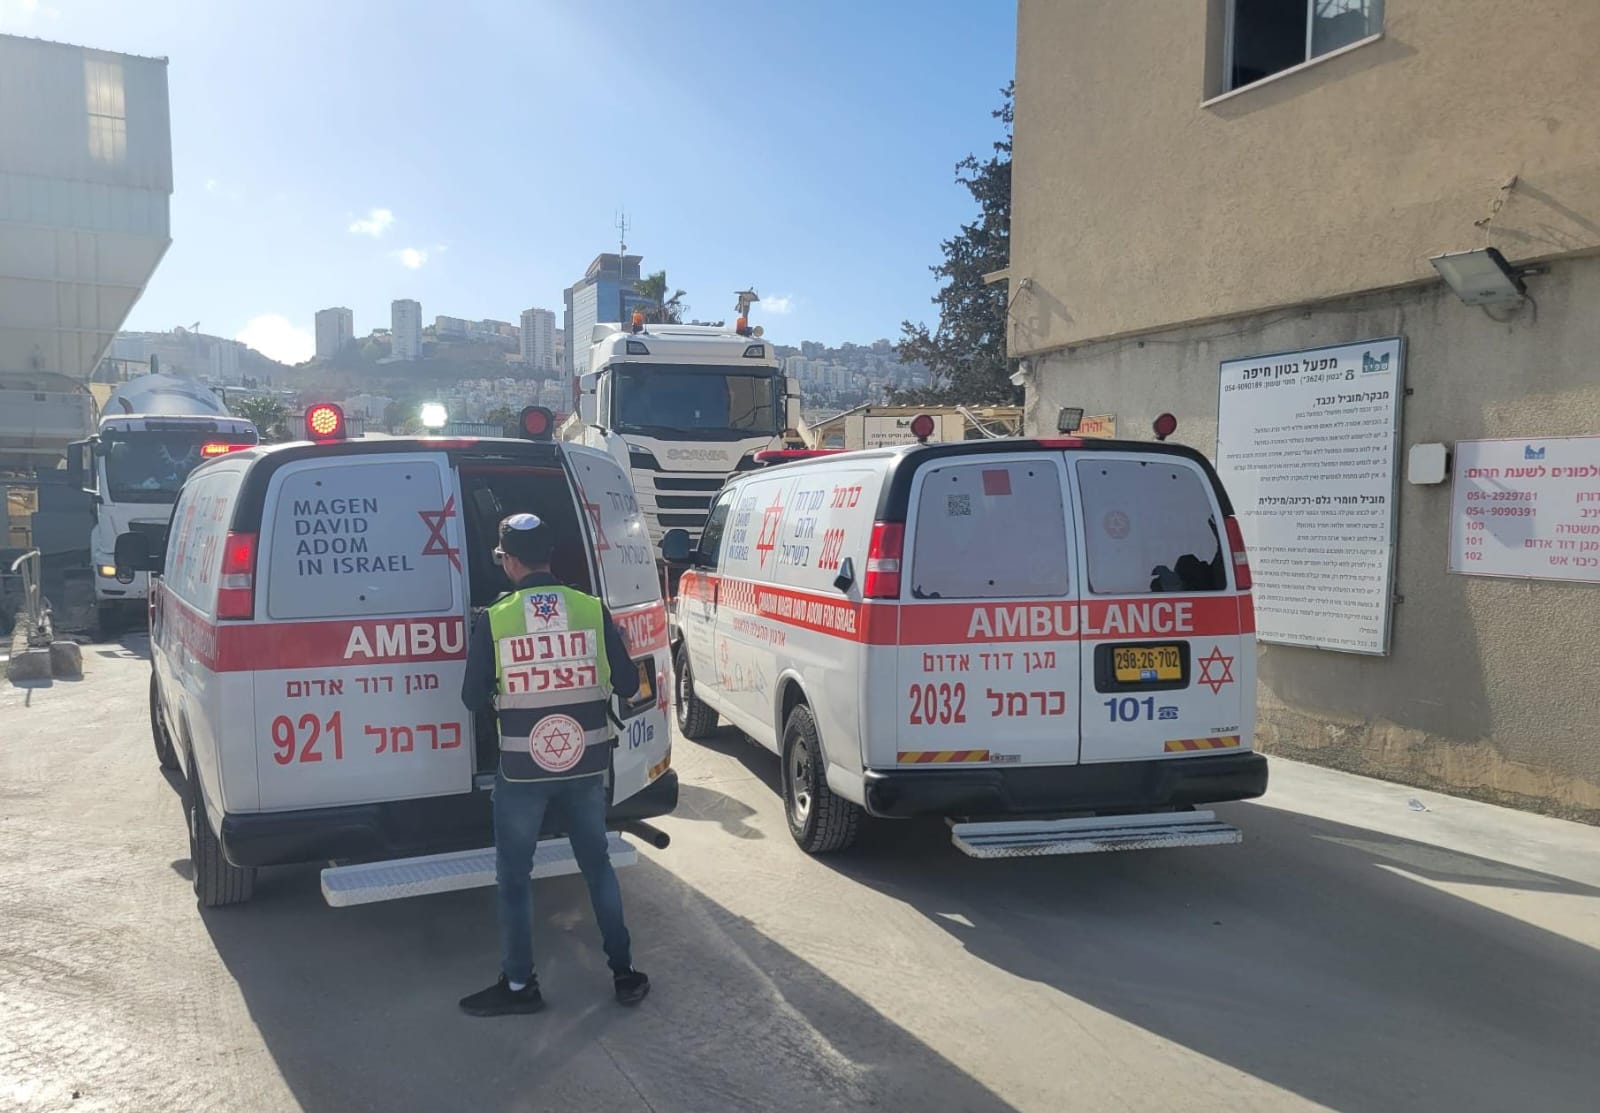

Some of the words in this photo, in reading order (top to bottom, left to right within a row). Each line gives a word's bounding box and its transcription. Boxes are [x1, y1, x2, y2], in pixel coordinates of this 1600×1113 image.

[1243, 368, 1271, 381] חיפה
[1275, 363, 1299, 378] בטון
[1303, 358, 1338, 372] מפעל
[1338, 391, 1389, 403] מבקר/מוביל
[1464, 468, 1500, 479] חרום:
[1504, 465, 1546, 478] לשעת
[1552, 465, 1600, 478] לפונים
[830, 485, 862, 508] כרמל
[1334, 496, 1358, 505] חומרי
[1360, 494, 1385, 505] מוביל
[1467, 491, 1538, 501] 054-2929781
[293, 498, 378, 516] MAGEN
[1465, 506, 1536, 517] 054-9090391
[295, 517, 368, 536] DAVID
[1466, 521, 1484, 531] 100
[1556, 524, 1600, 535] משטרה
[296, 537, 368, 556] ADOM
[818, 529, 845, 570] 2032
[1465, 536, 1483, 545] 101
[1524, 539, 1552, 549] אדום
[1557, 540, 1575, 550] דוד
[1580, 541, 1600, 553] מגן
[298, 557, 323, 576] IN
[334, 555, 415, 575] ISRAEL
[1464, 551, 1483, 561] 102
[1549, 555, 1568, 565] אש
[1573, 556, 1599, 567] כיבוי
[822, 604, 835, 628] FOR
[834, 606, 857, 634] ISRAEL
[967, 602, 1194, 637] AMBULANCE
[344, 621, 464, 659] AMBU
[510, 631, 587, 663] חובש
[923, 652, 969, 673] אדום
[980, 652, 1012, 671] דוד
[1024, 651, 1056, 674] מגן
[287, 678, 344, 698] אדום
[355, 675, 393, 694] דוד
[404, 673, 439, 695] מגן
[508, 665, 597, 693] הצלה
[909, 682, 967, 725] 2032
[986, 688, 1066, 717] כרמל
[1104, 696, 1155, 722] 101
[271, 711, 343, 766] 921
[365, 722, 461, 754] כרמל
[627, 717, 646, 750] 101
